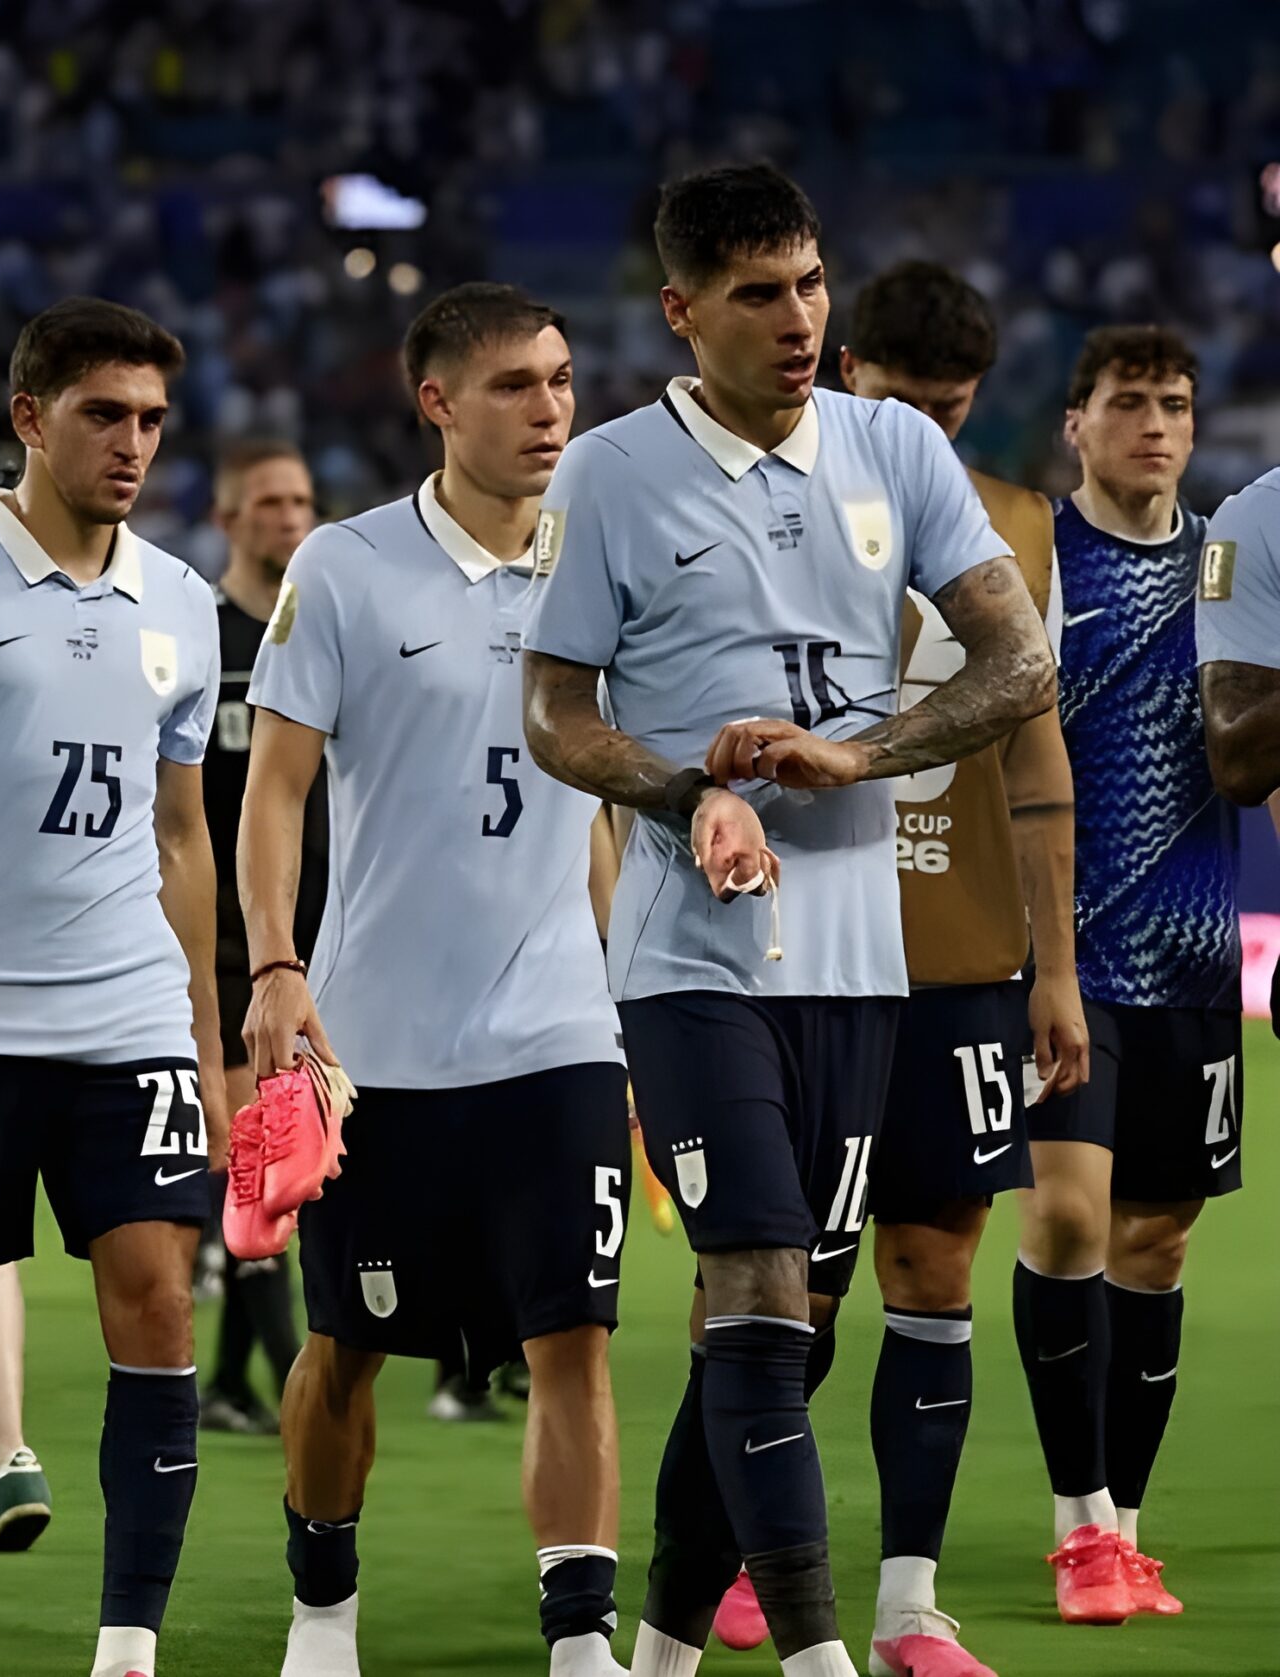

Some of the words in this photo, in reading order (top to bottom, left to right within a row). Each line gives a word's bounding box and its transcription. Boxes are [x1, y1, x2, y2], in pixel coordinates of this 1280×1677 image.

[38, 740, 122, 838] 25
[482, 747, 523, 837] 5
[904, 813, 952, 835] CUP
[136, 1069, 208, 1156] 25
[953, 1043, 1012, 1134] 15
[595, 1166, 624, 1258] 5
